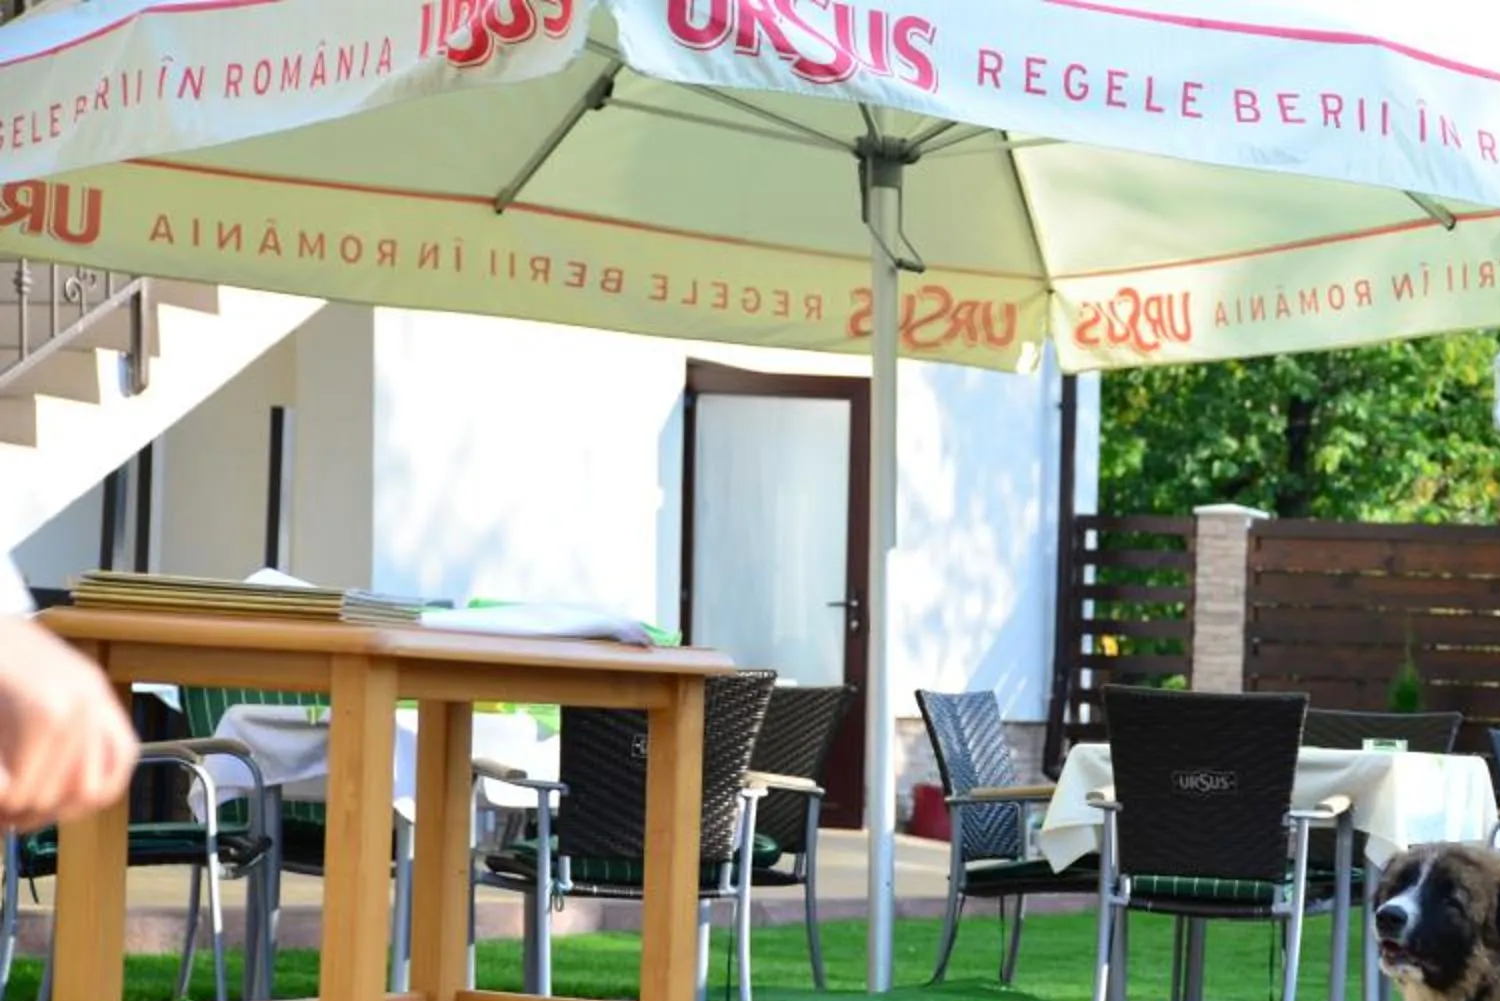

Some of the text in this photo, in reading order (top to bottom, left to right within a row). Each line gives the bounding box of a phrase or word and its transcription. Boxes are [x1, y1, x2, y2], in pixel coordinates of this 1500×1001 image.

[0, 103, 62, 149] ELE
[224, 35, 393, 98] ROMÂNIA
[977, 48, 1203, 119] REGELE
[1233, 88, 1389, 137] BERII
